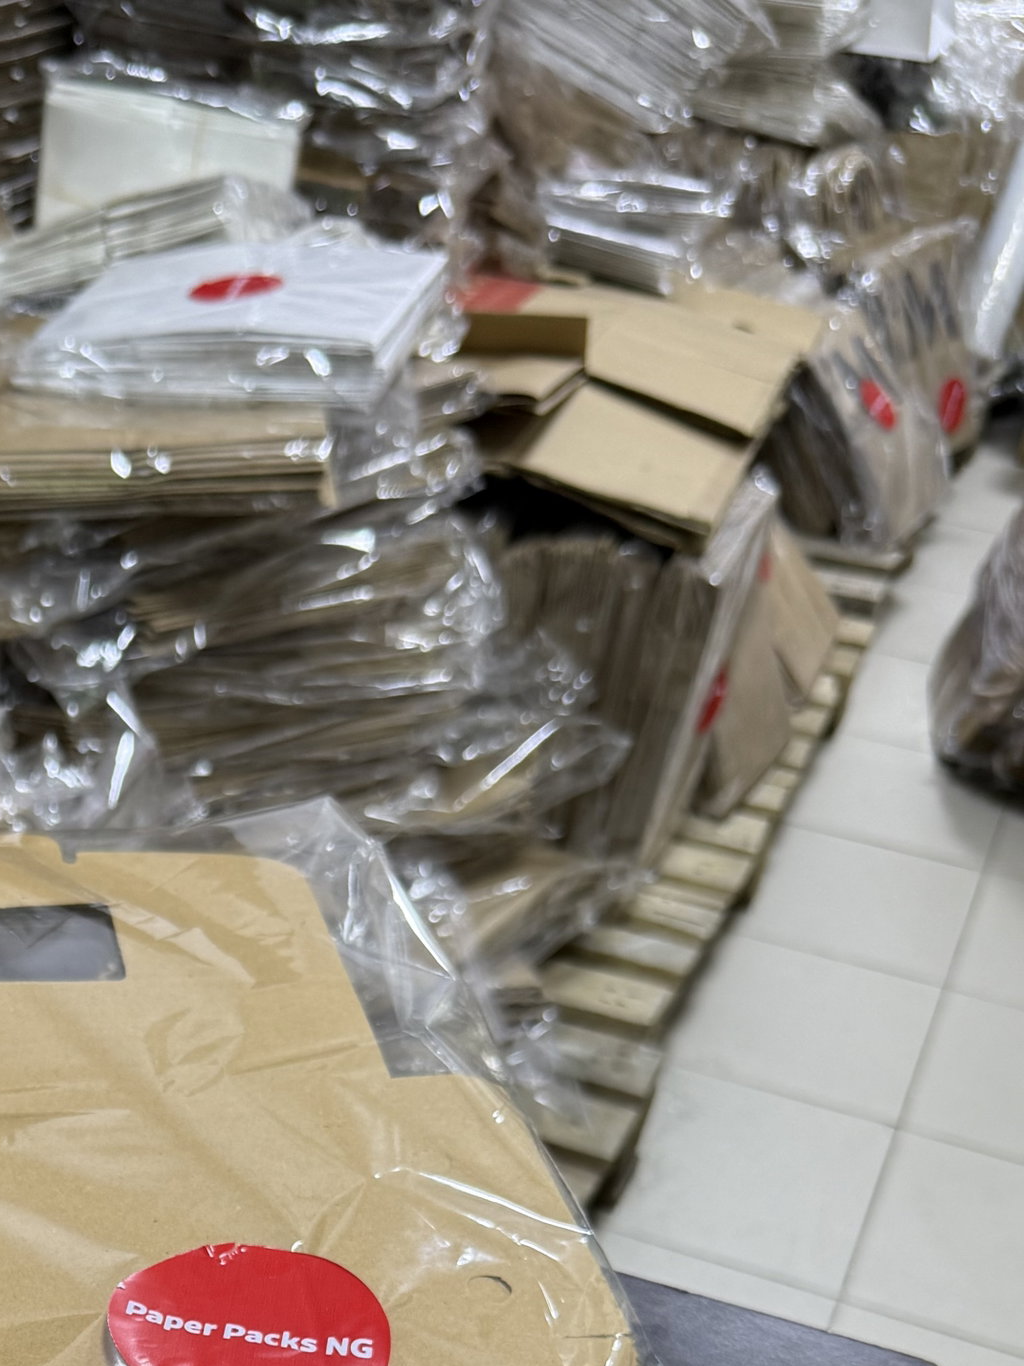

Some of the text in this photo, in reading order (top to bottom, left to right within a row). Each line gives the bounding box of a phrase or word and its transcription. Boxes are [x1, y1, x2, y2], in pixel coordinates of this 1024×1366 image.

[126, 1300, 374, 1359] Paper Packs NG
